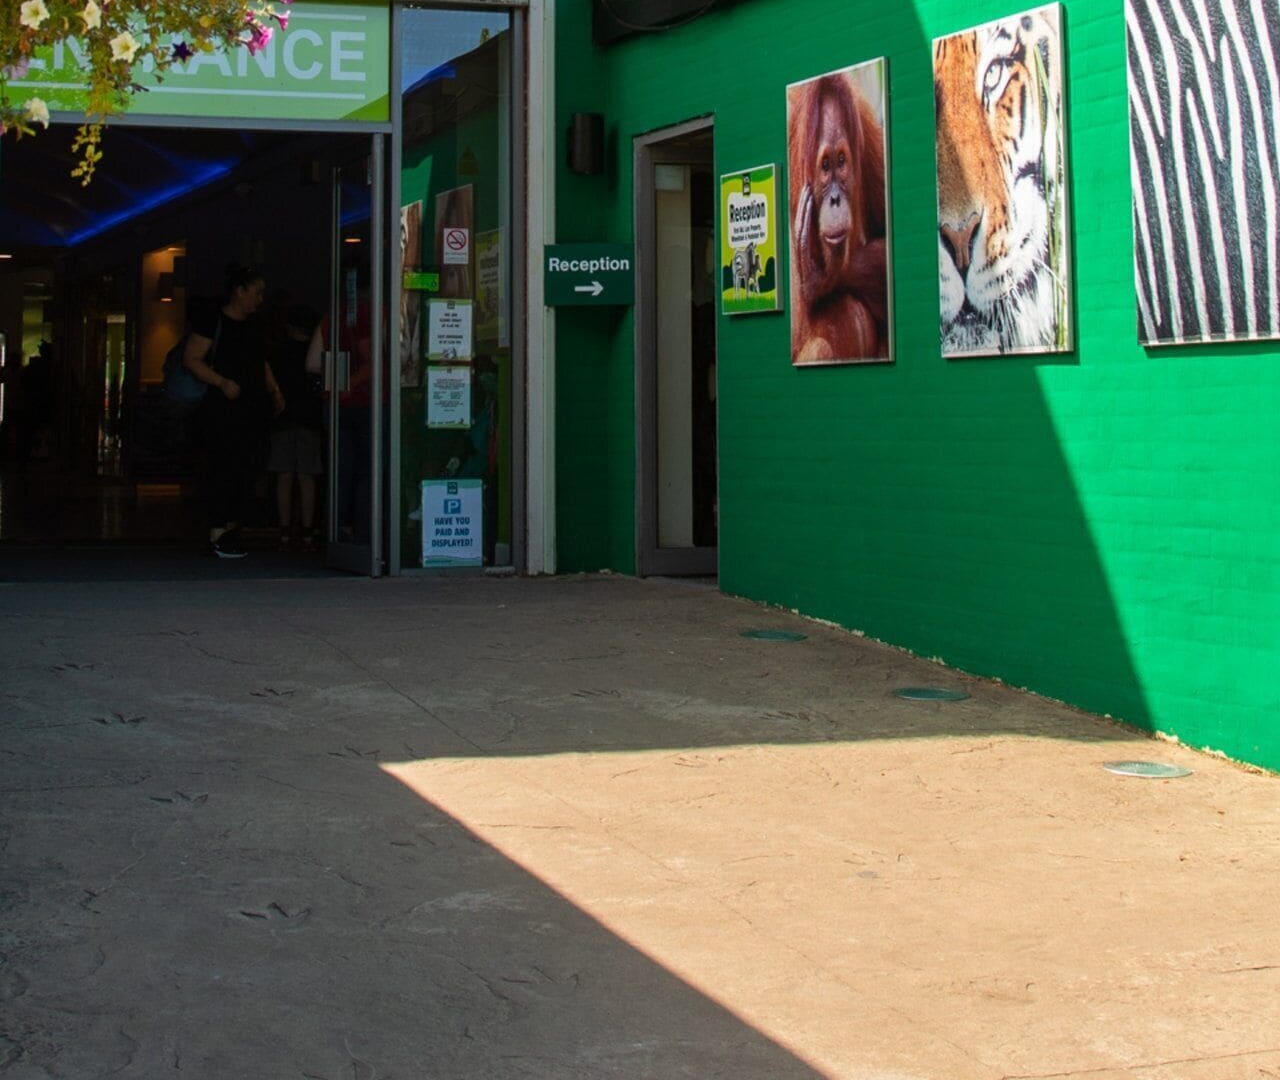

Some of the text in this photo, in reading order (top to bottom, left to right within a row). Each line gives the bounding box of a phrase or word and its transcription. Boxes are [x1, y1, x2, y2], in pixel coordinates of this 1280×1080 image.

[23, 18, 366, 81] NRANCE
[729, 200, 766, 224] Reception
[548, 257, 630, 274] Reception
[434, 517, 470, 525] HAVE YOU
[435, 528, 470, 536] PAID AND
